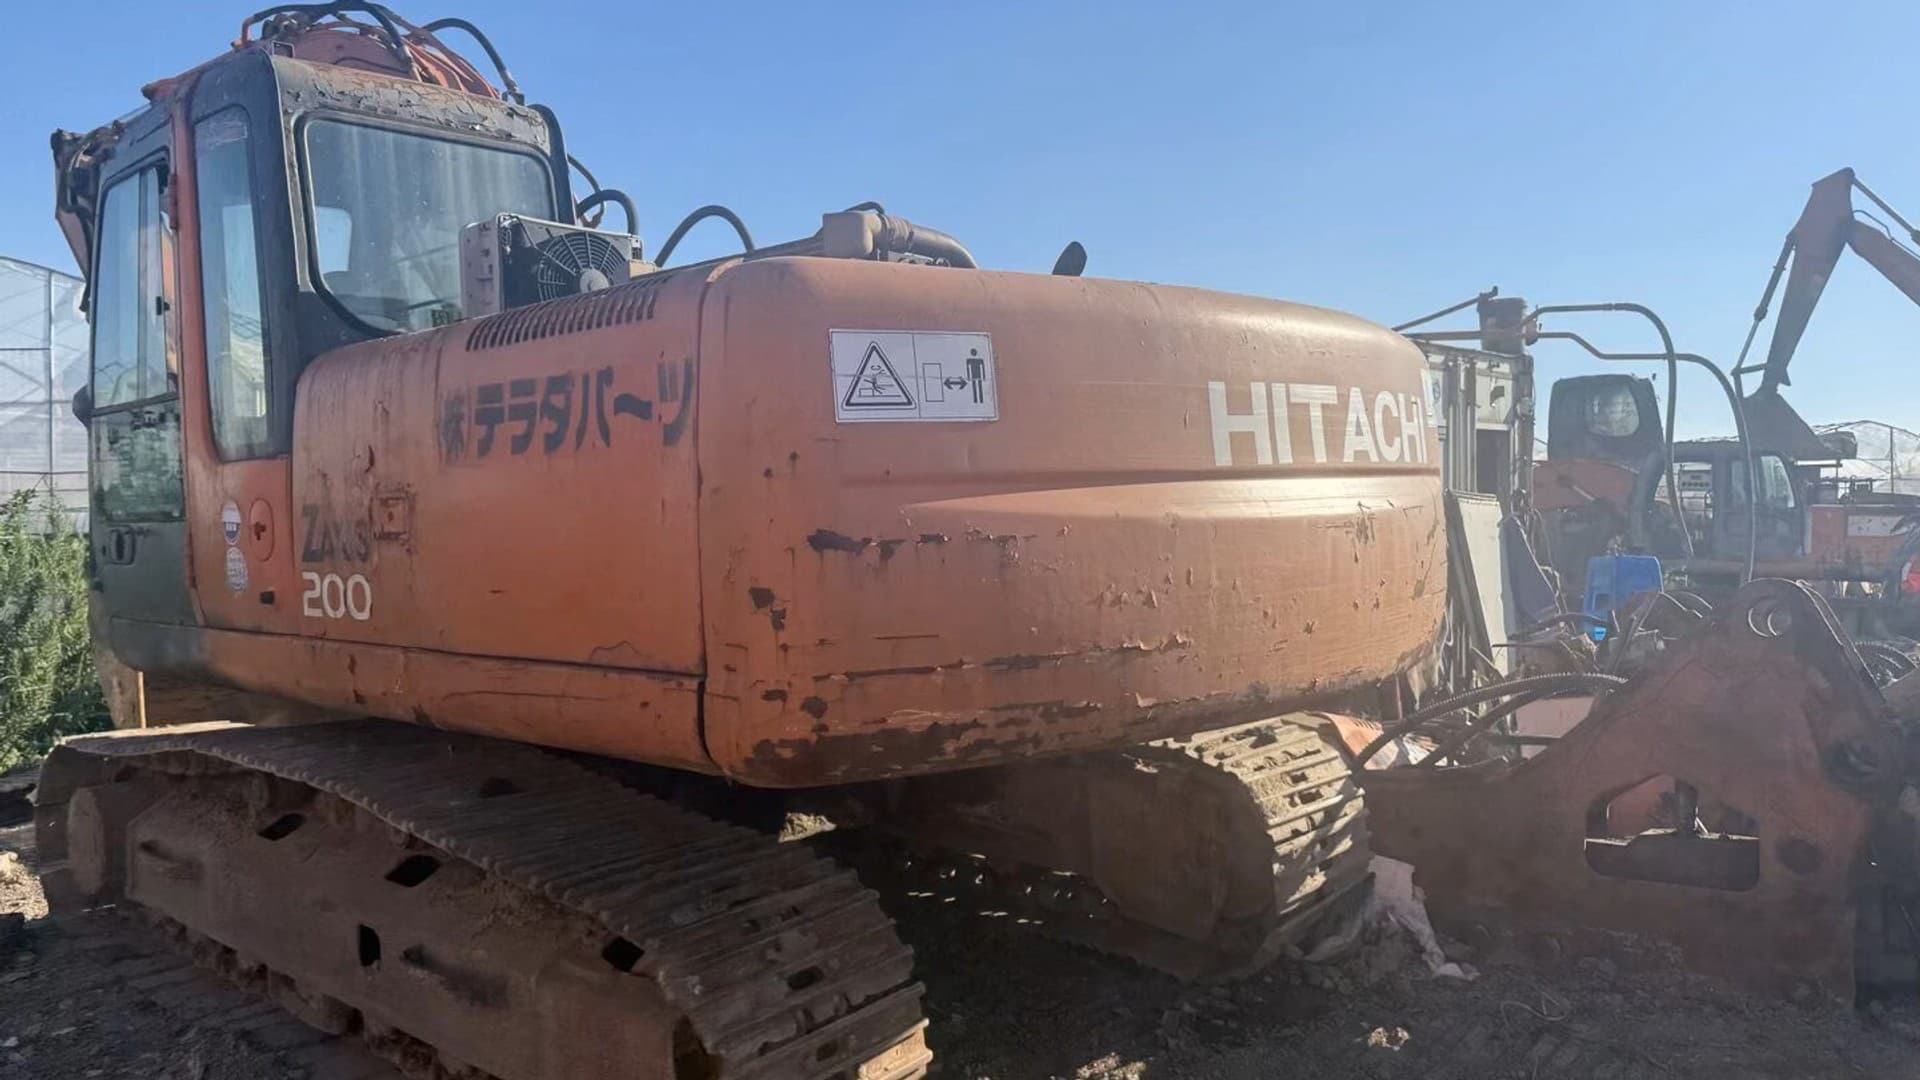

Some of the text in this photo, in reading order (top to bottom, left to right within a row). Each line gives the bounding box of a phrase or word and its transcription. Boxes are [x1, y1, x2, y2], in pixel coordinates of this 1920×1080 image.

[1207, 380, 1428, 467] HITACHI
[301, 503, 370, 563] ZAXS
[301, 571, 372, 621] 200
